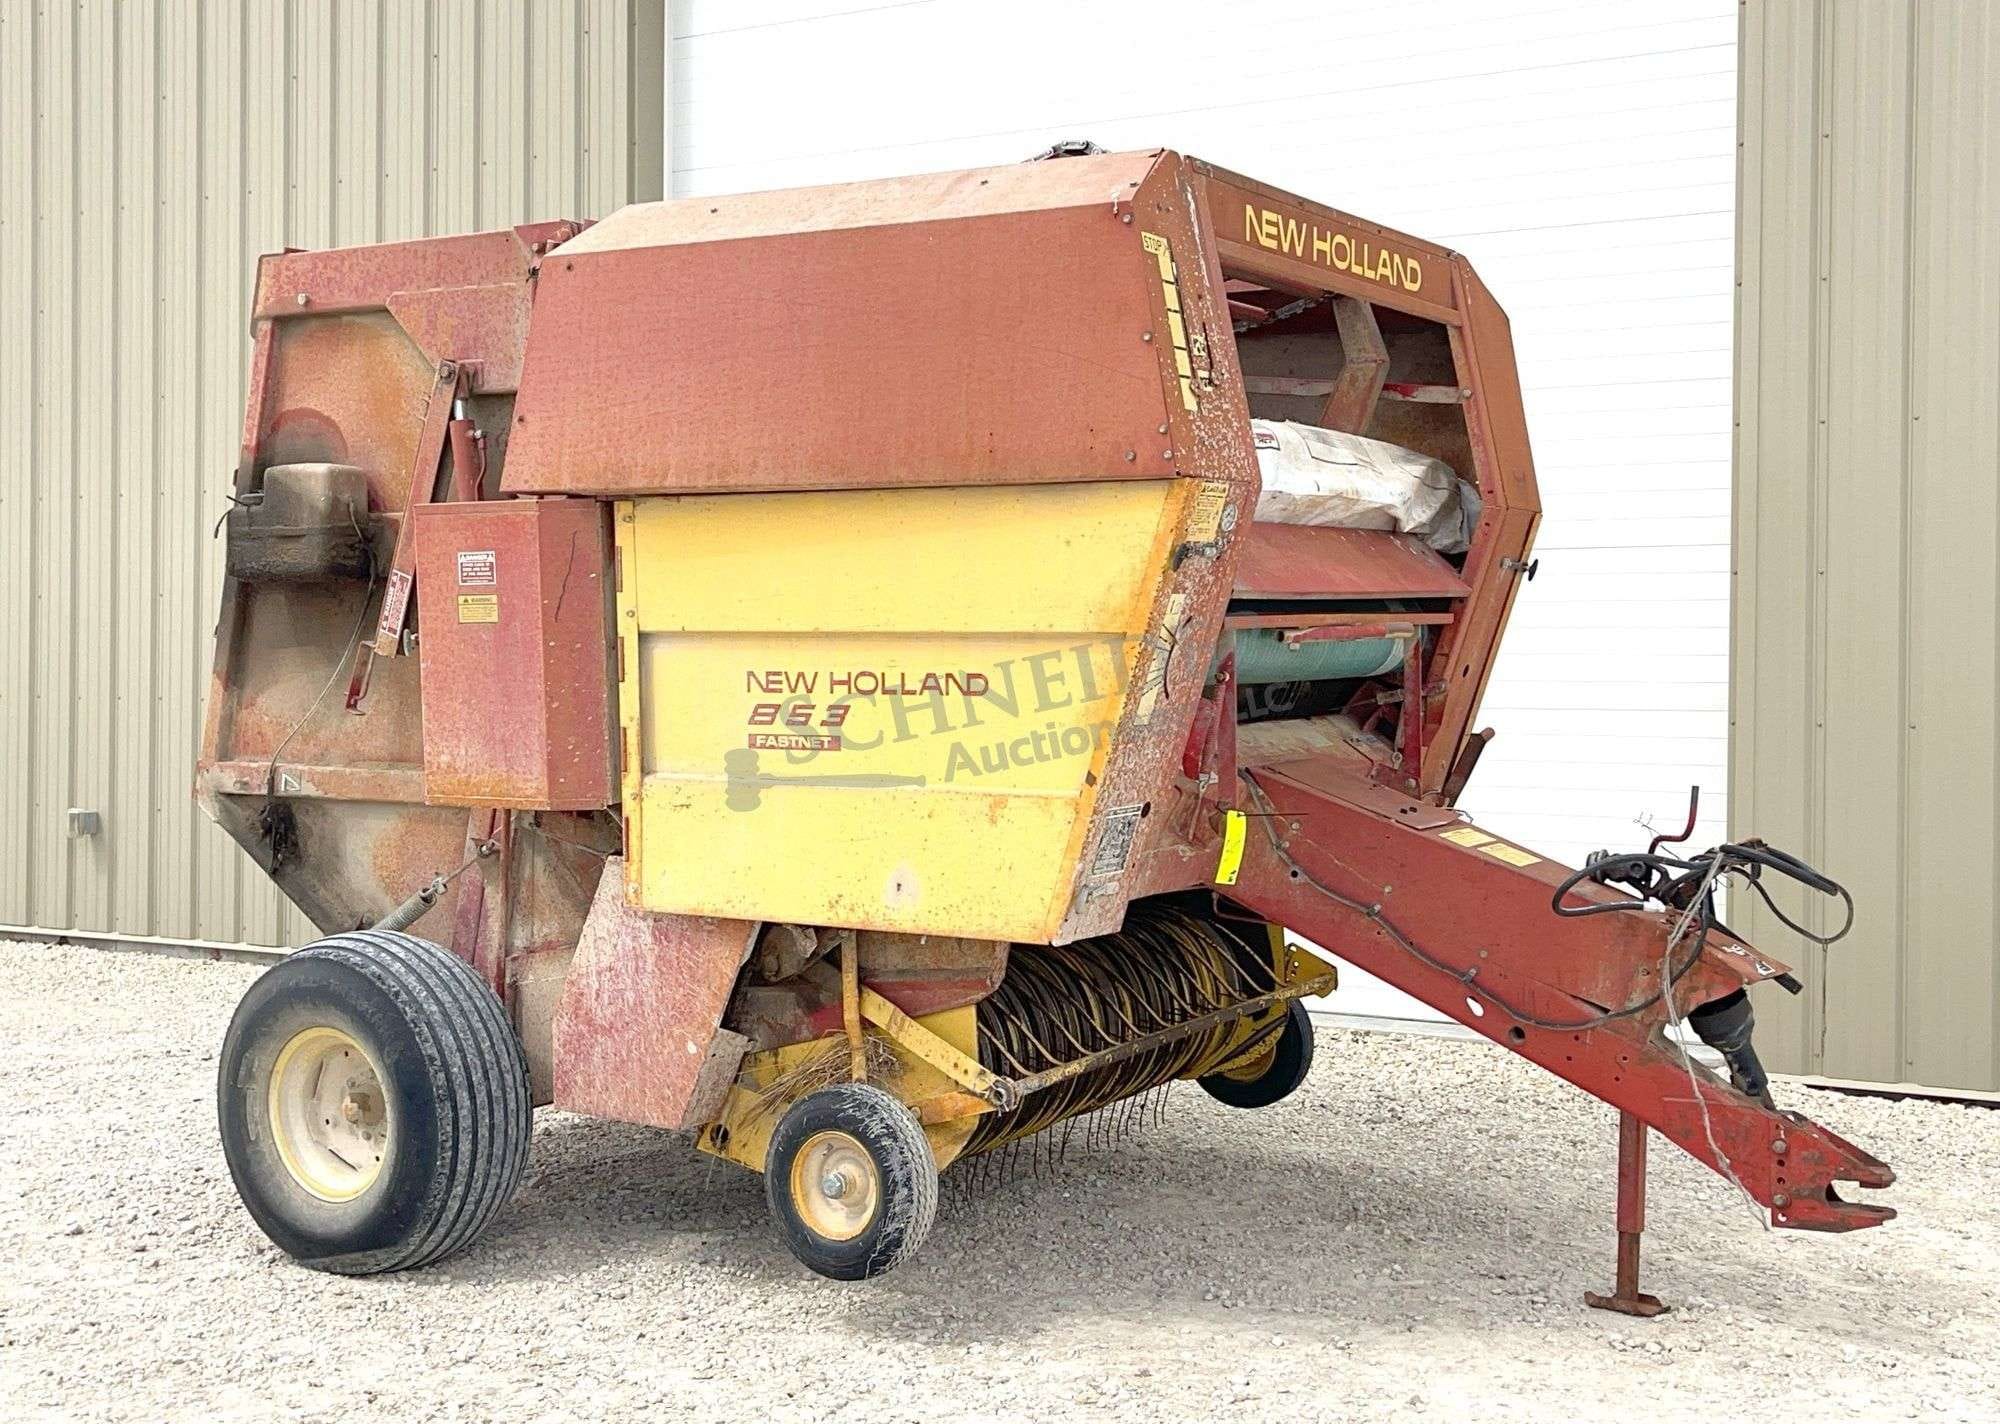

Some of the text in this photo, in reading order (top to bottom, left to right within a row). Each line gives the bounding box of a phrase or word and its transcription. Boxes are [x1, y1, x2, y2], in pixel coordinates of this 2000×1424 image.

[1144, 235, 1161, 252] STOP
[1246, 204, 1422, 292] NEW HOLLAND
[746, 671, 989, 696] NEW HOLLAND
[748, 704, 851, 726] 853
[756, 736, 832, 749] FASTNET
